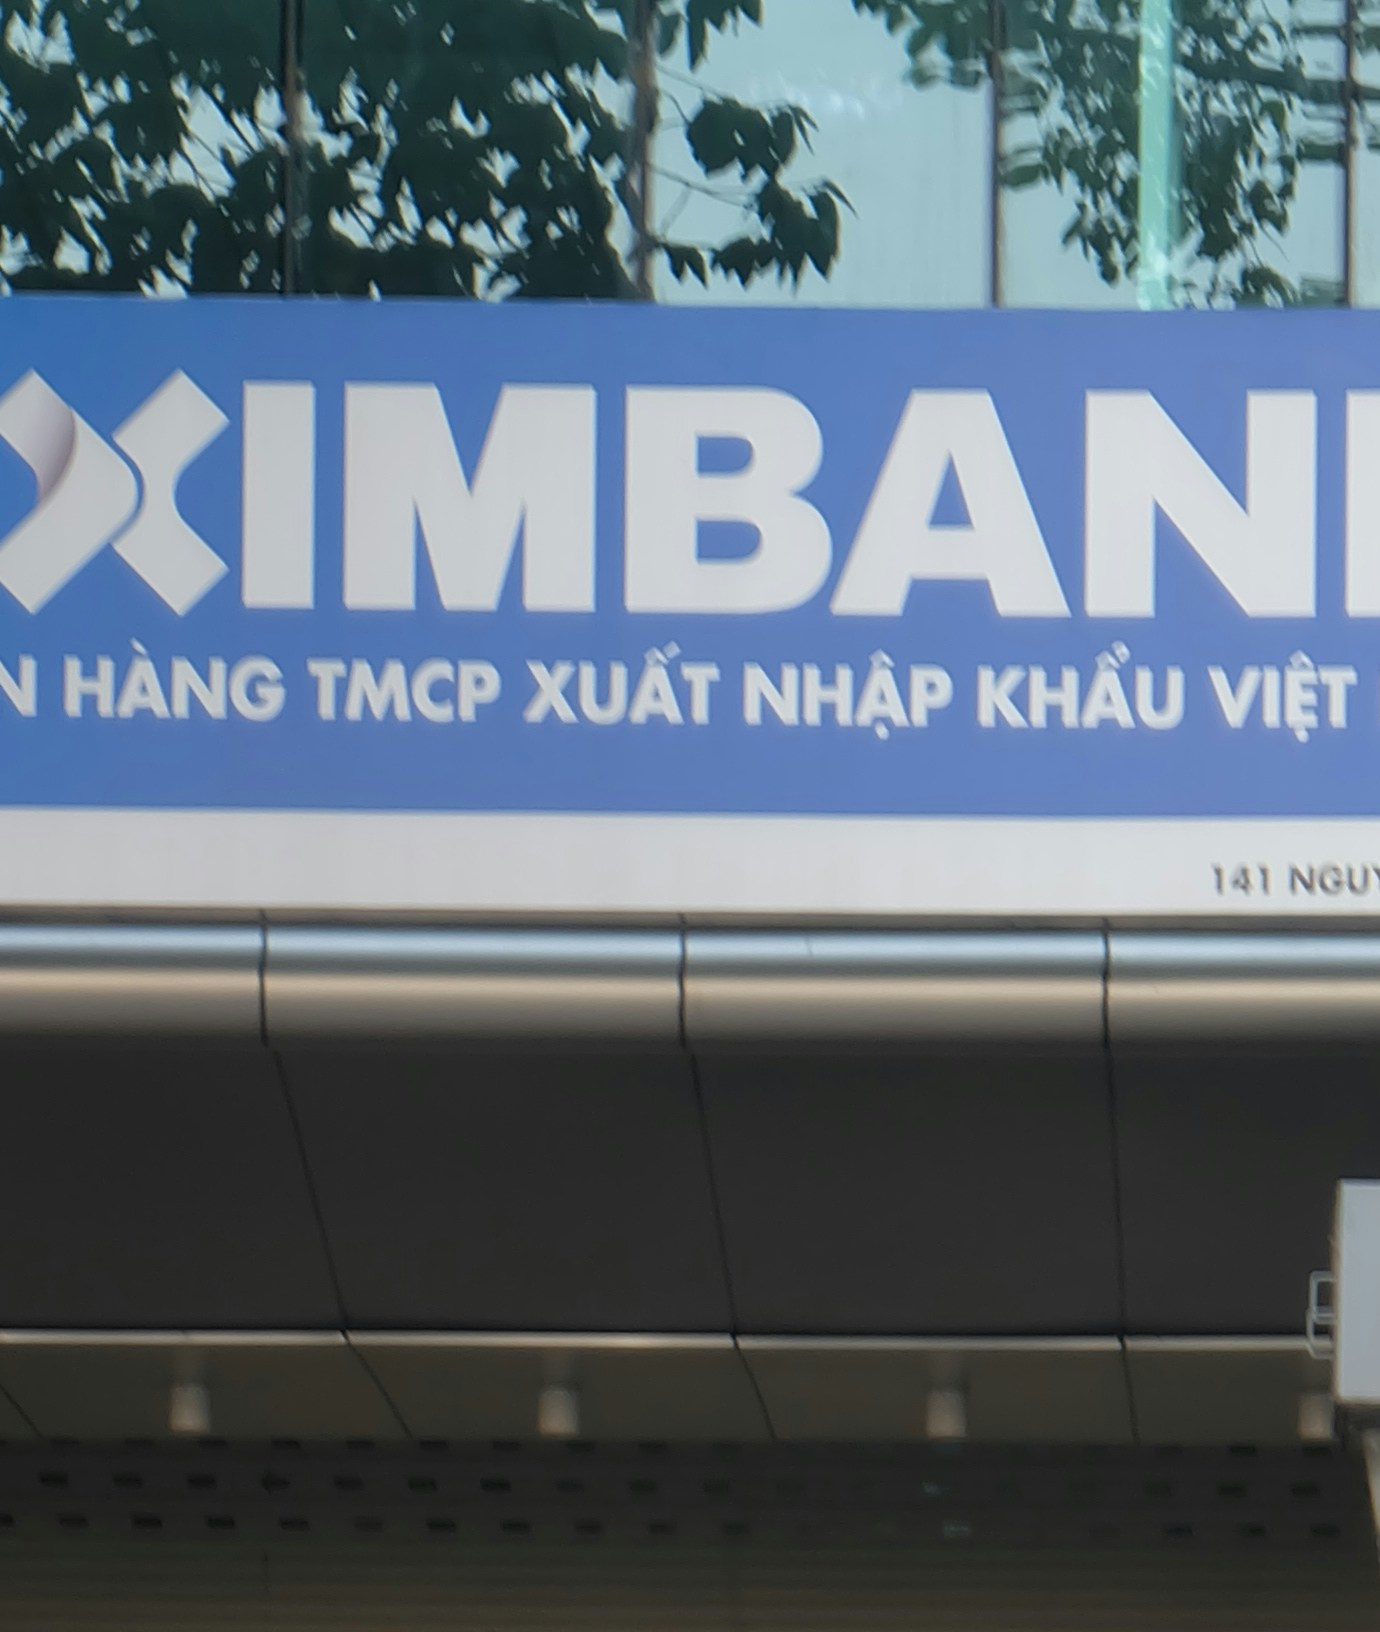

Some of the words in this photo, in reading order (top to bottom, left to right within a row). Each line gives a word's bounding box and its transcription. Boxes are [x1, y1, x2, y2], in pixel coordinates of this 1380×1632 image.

[63, 638, 287, 723] HÀNG
[307, 657, 501, 724] TMCP
[522, 641, 720, 726] XUẤT
[743, 649, 953, 741] NHẬP
[977, 641, 1185, 729] KHẨU
[1208, 649, 1358, 743] VIỆT
[1211, 863, 1272, 895] 141
